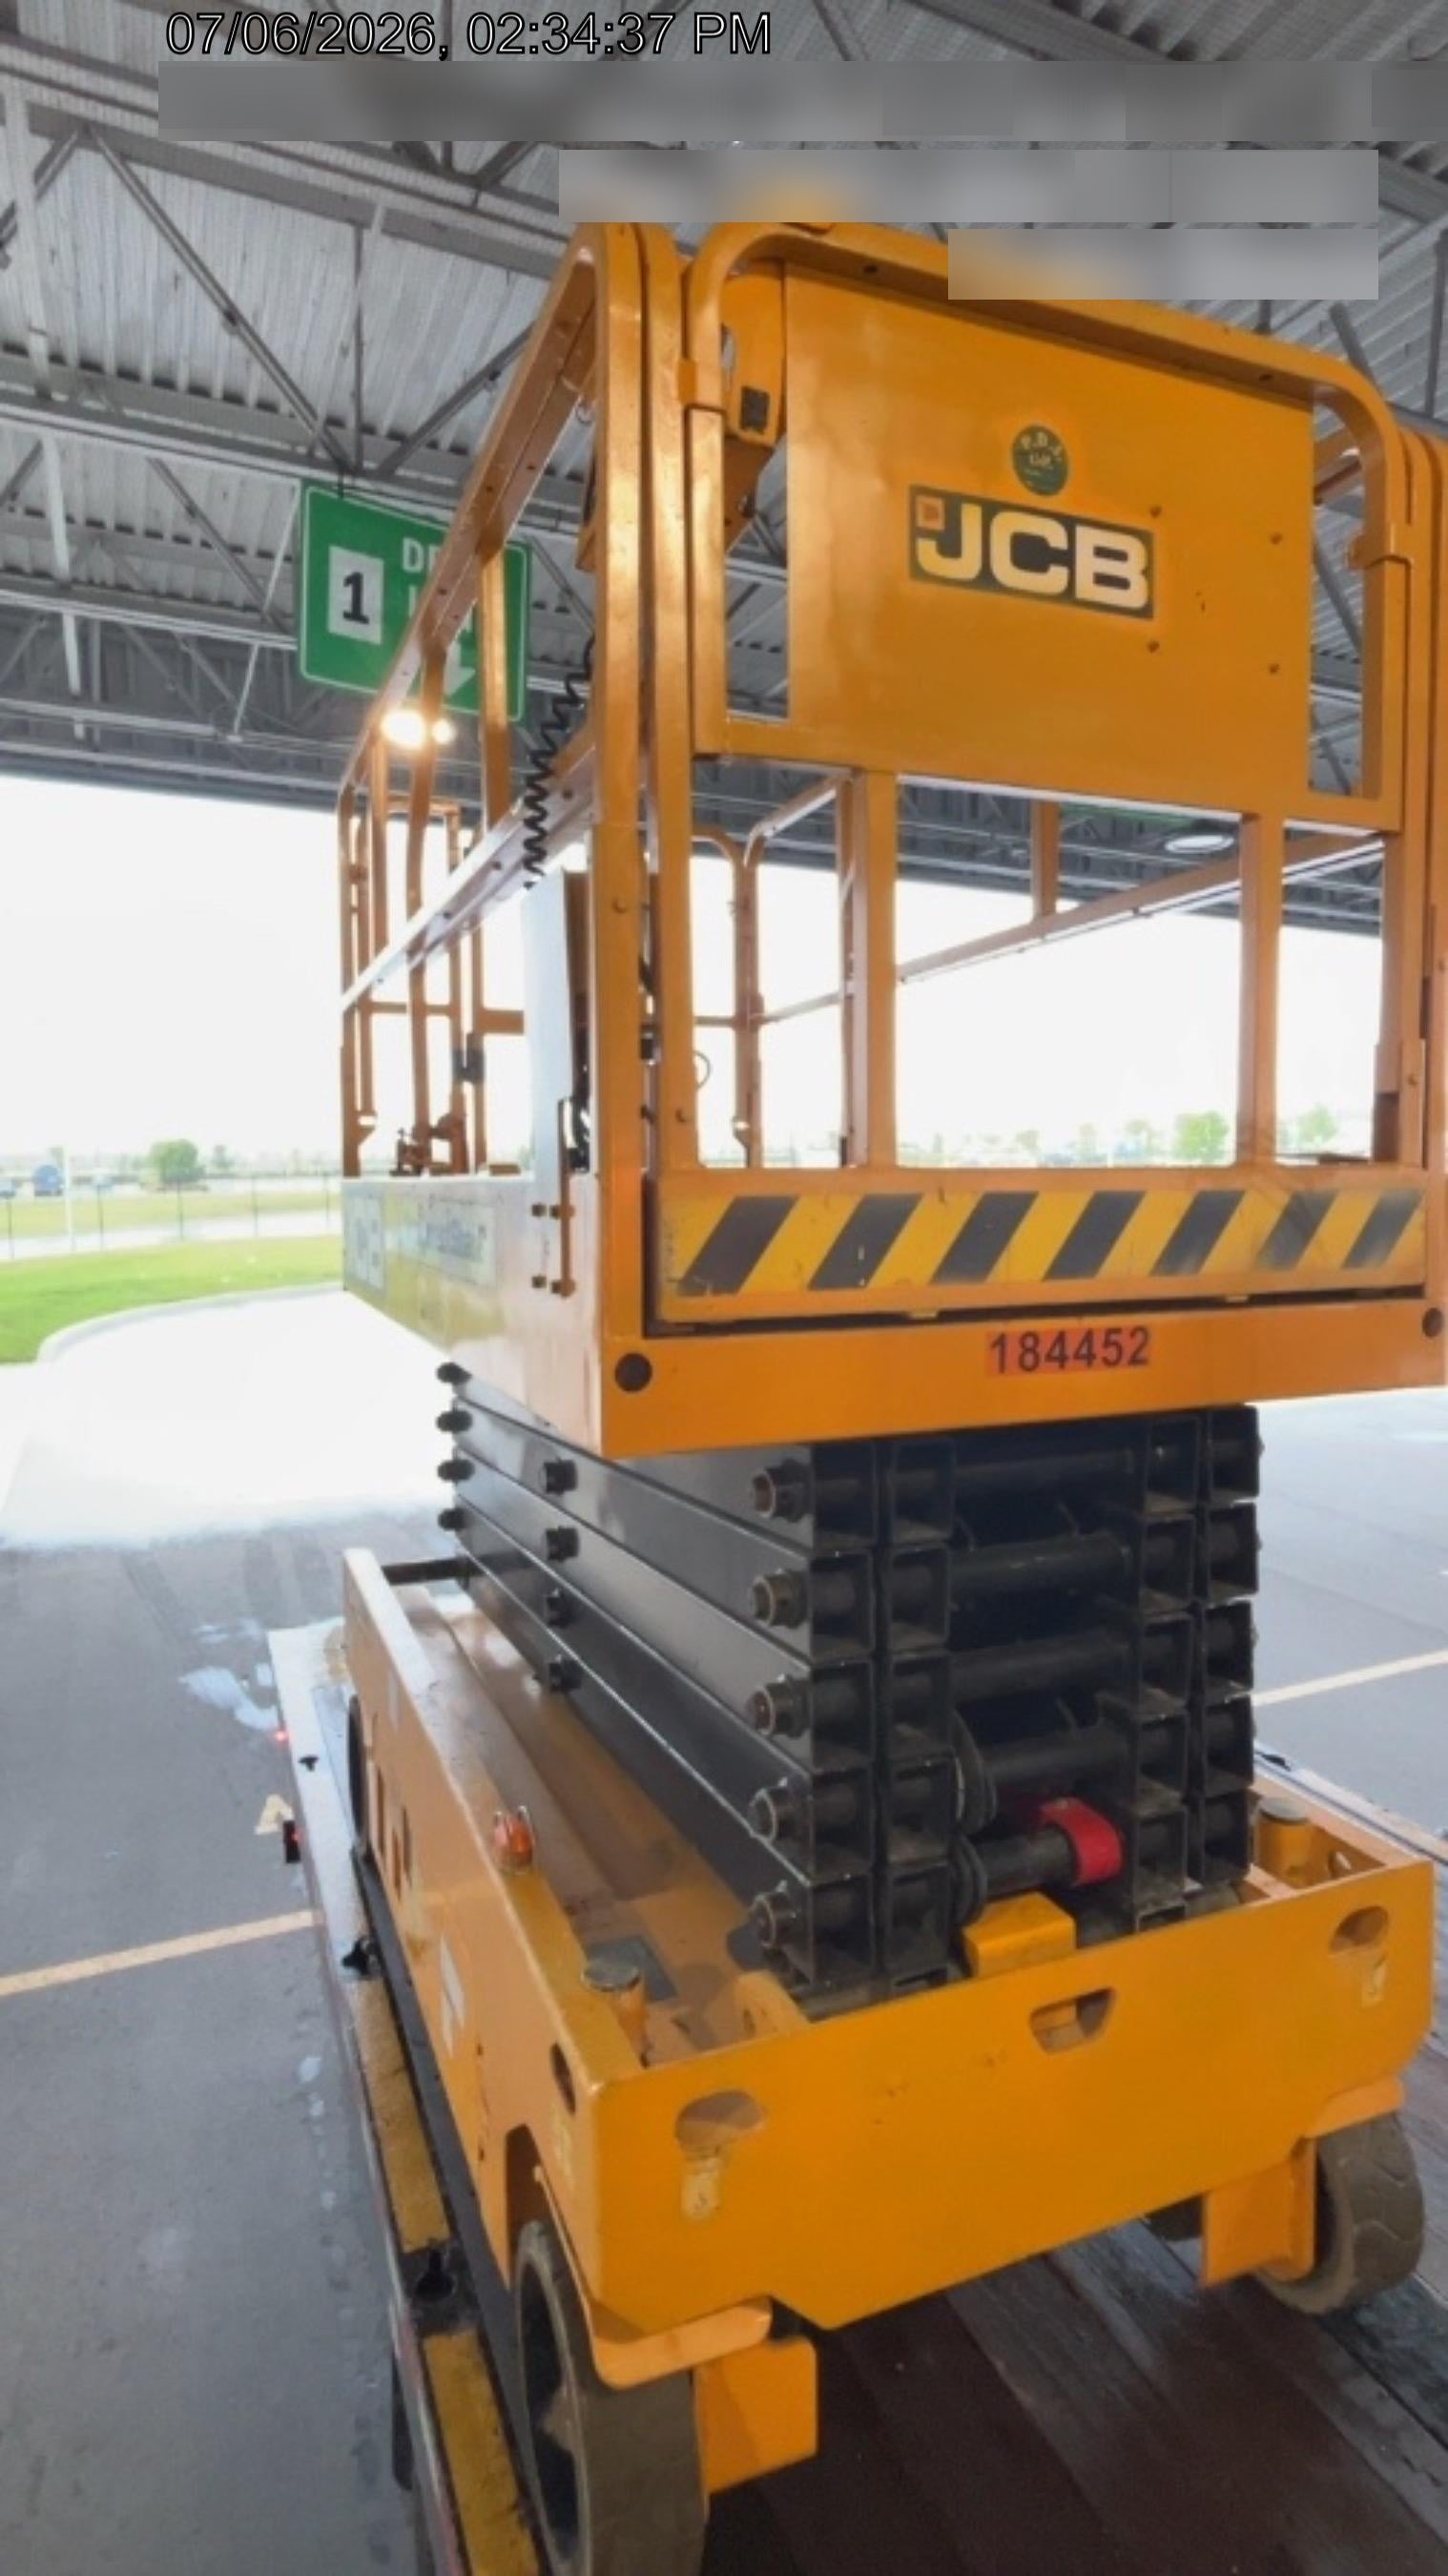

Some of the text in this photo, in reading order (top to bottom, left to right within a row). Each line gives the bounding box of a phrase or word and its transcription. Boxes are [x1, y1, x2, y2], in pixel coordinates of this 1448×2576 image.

[916, 502, 1148, 610] JCB
[341, 571, 370, 625] 1
[989, 1324, 1150, 1375] 184452
